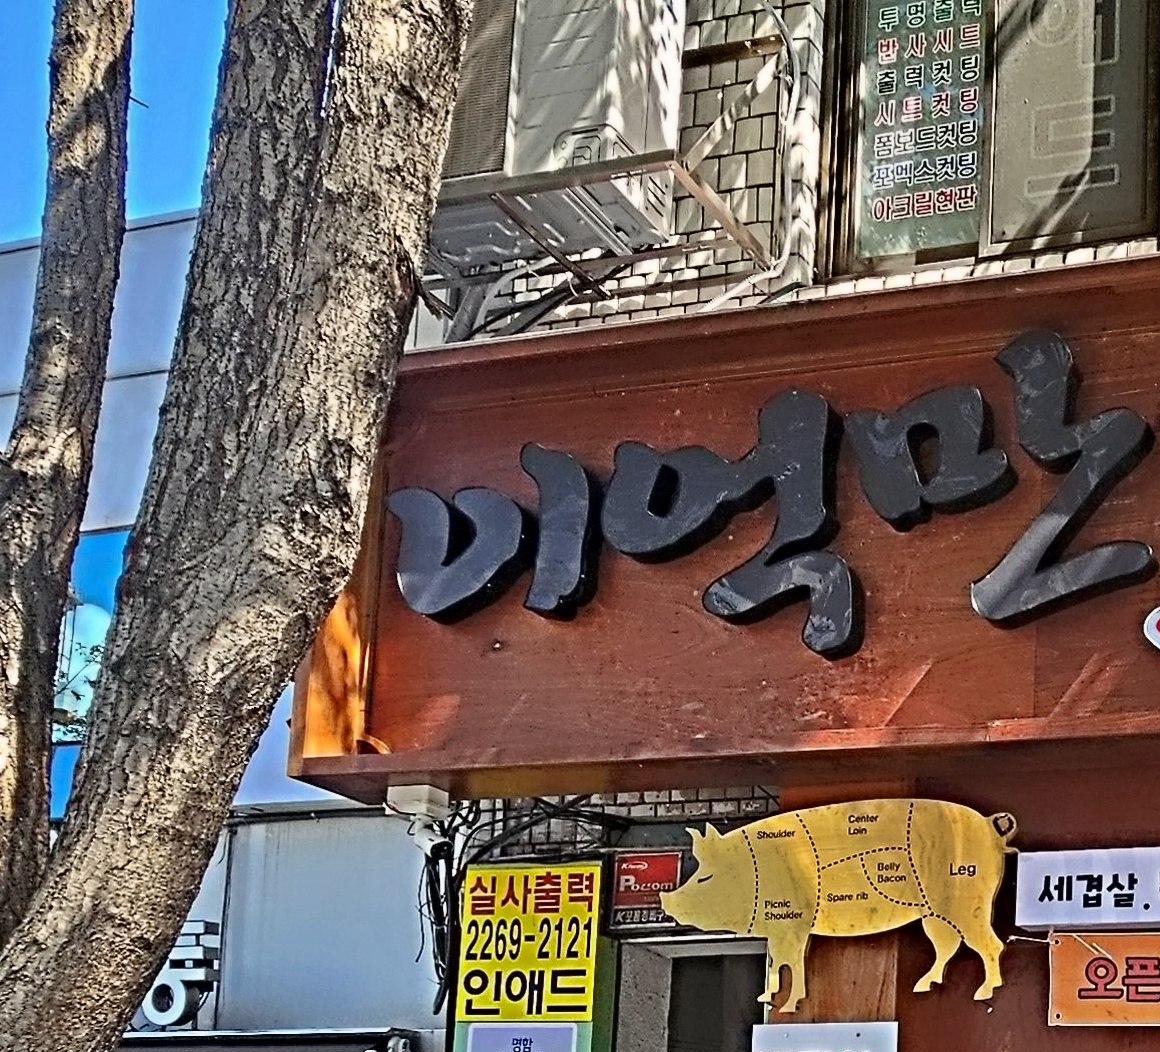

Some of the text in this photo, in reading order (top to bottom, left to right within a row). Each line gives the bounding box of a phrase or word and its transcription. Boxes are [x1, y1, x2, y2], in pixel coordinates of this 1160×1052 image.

[874, 87, 979, 126] 시트컷팅
[874, 120, 978, 158] 폼보드컷팅
[873, 152, 977, 189] 포멕스컷팅
[872, 185, 976, 222] 아크릴현판
[848, 814, 879, 824] Center
[756, 828, 796, 840] Shoulder
[848, 826, 868, 836] Loin
[877, 862, 901, 873] Belly
[949, 862, 977, 877] Leg
[877, 874, 907, 884] Bacon
[468, 871, 595, 915] 실사출력
[827, 891, 869, 903] Spare rib
[764, 899, 792, 910] Picnic
[764, 910, 804, 921] Shoulder
[465, 916, 593, 961] 2269-2121
[462, 968, 588, 1016] 인애드
[512, 1038, 533, 1052] 명함
